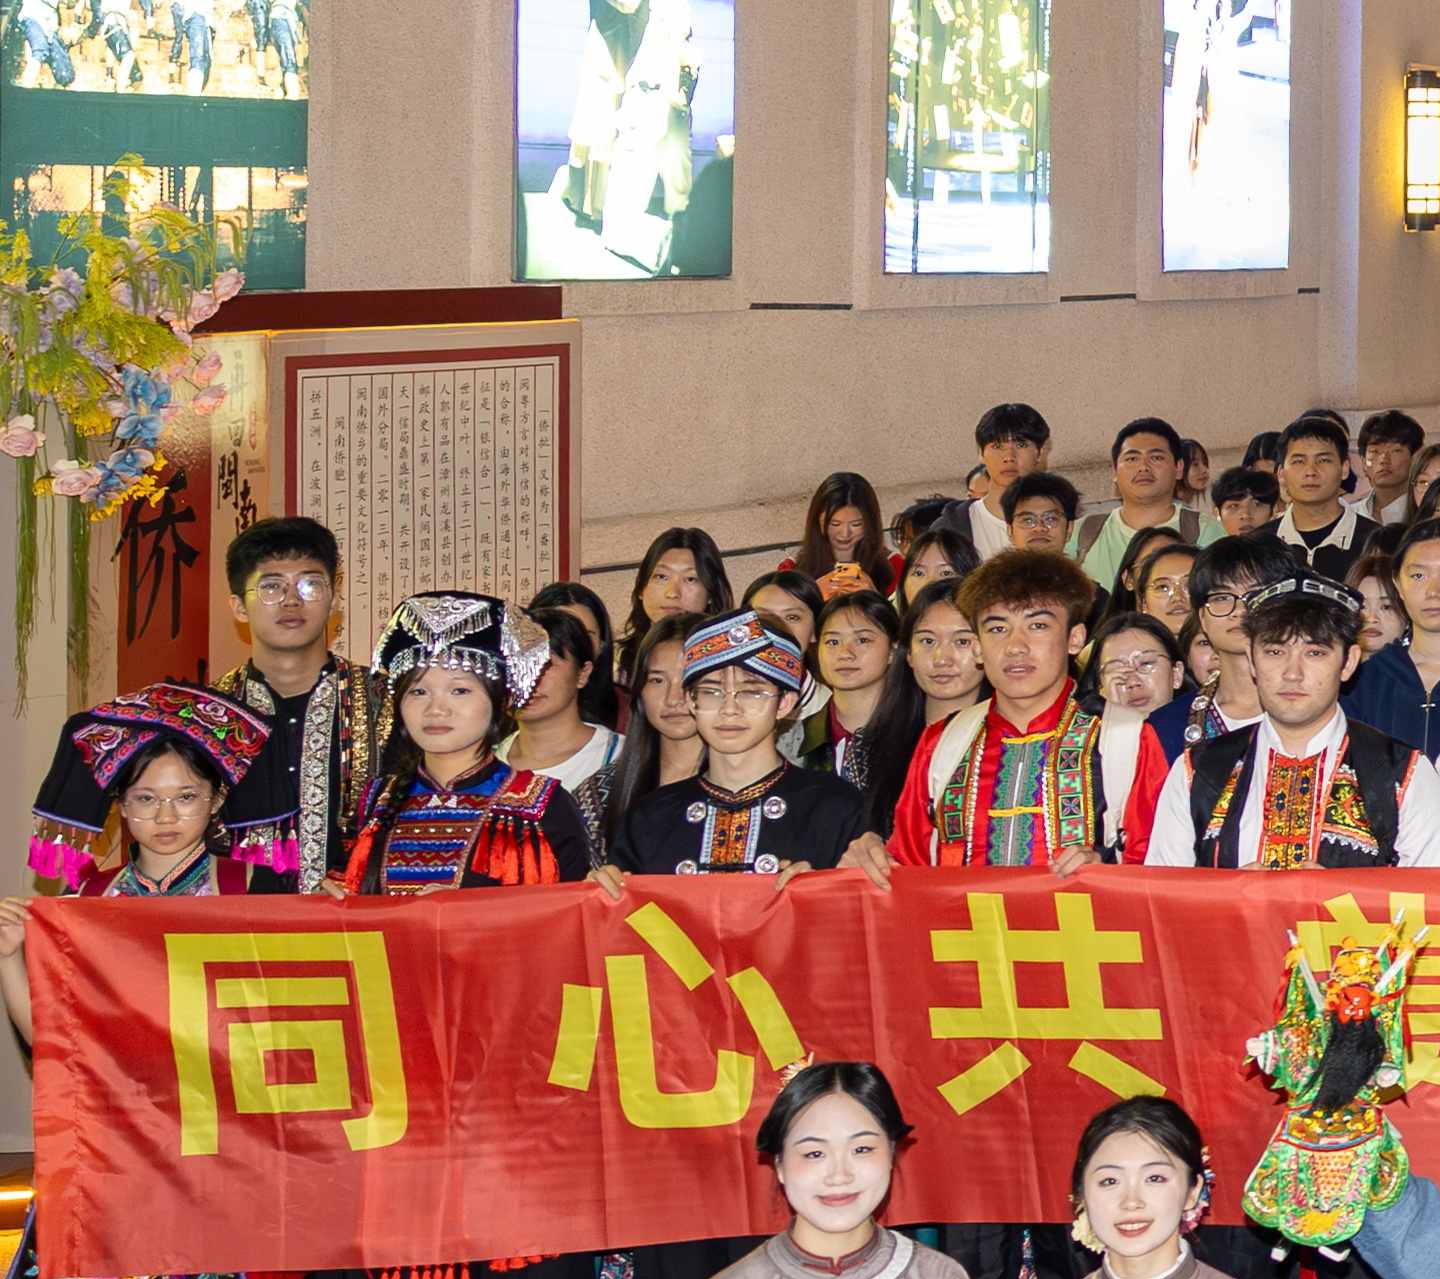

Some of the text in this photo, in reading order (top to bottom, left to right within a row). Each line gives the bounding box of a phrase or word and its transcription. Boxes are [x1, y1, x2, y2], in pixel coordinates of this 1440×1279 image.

[419, 385, 432, 592] 邮政史上第一家民间国际邮
[459, 382, 473, 592] 世纪中叶，终止于二十世纪
